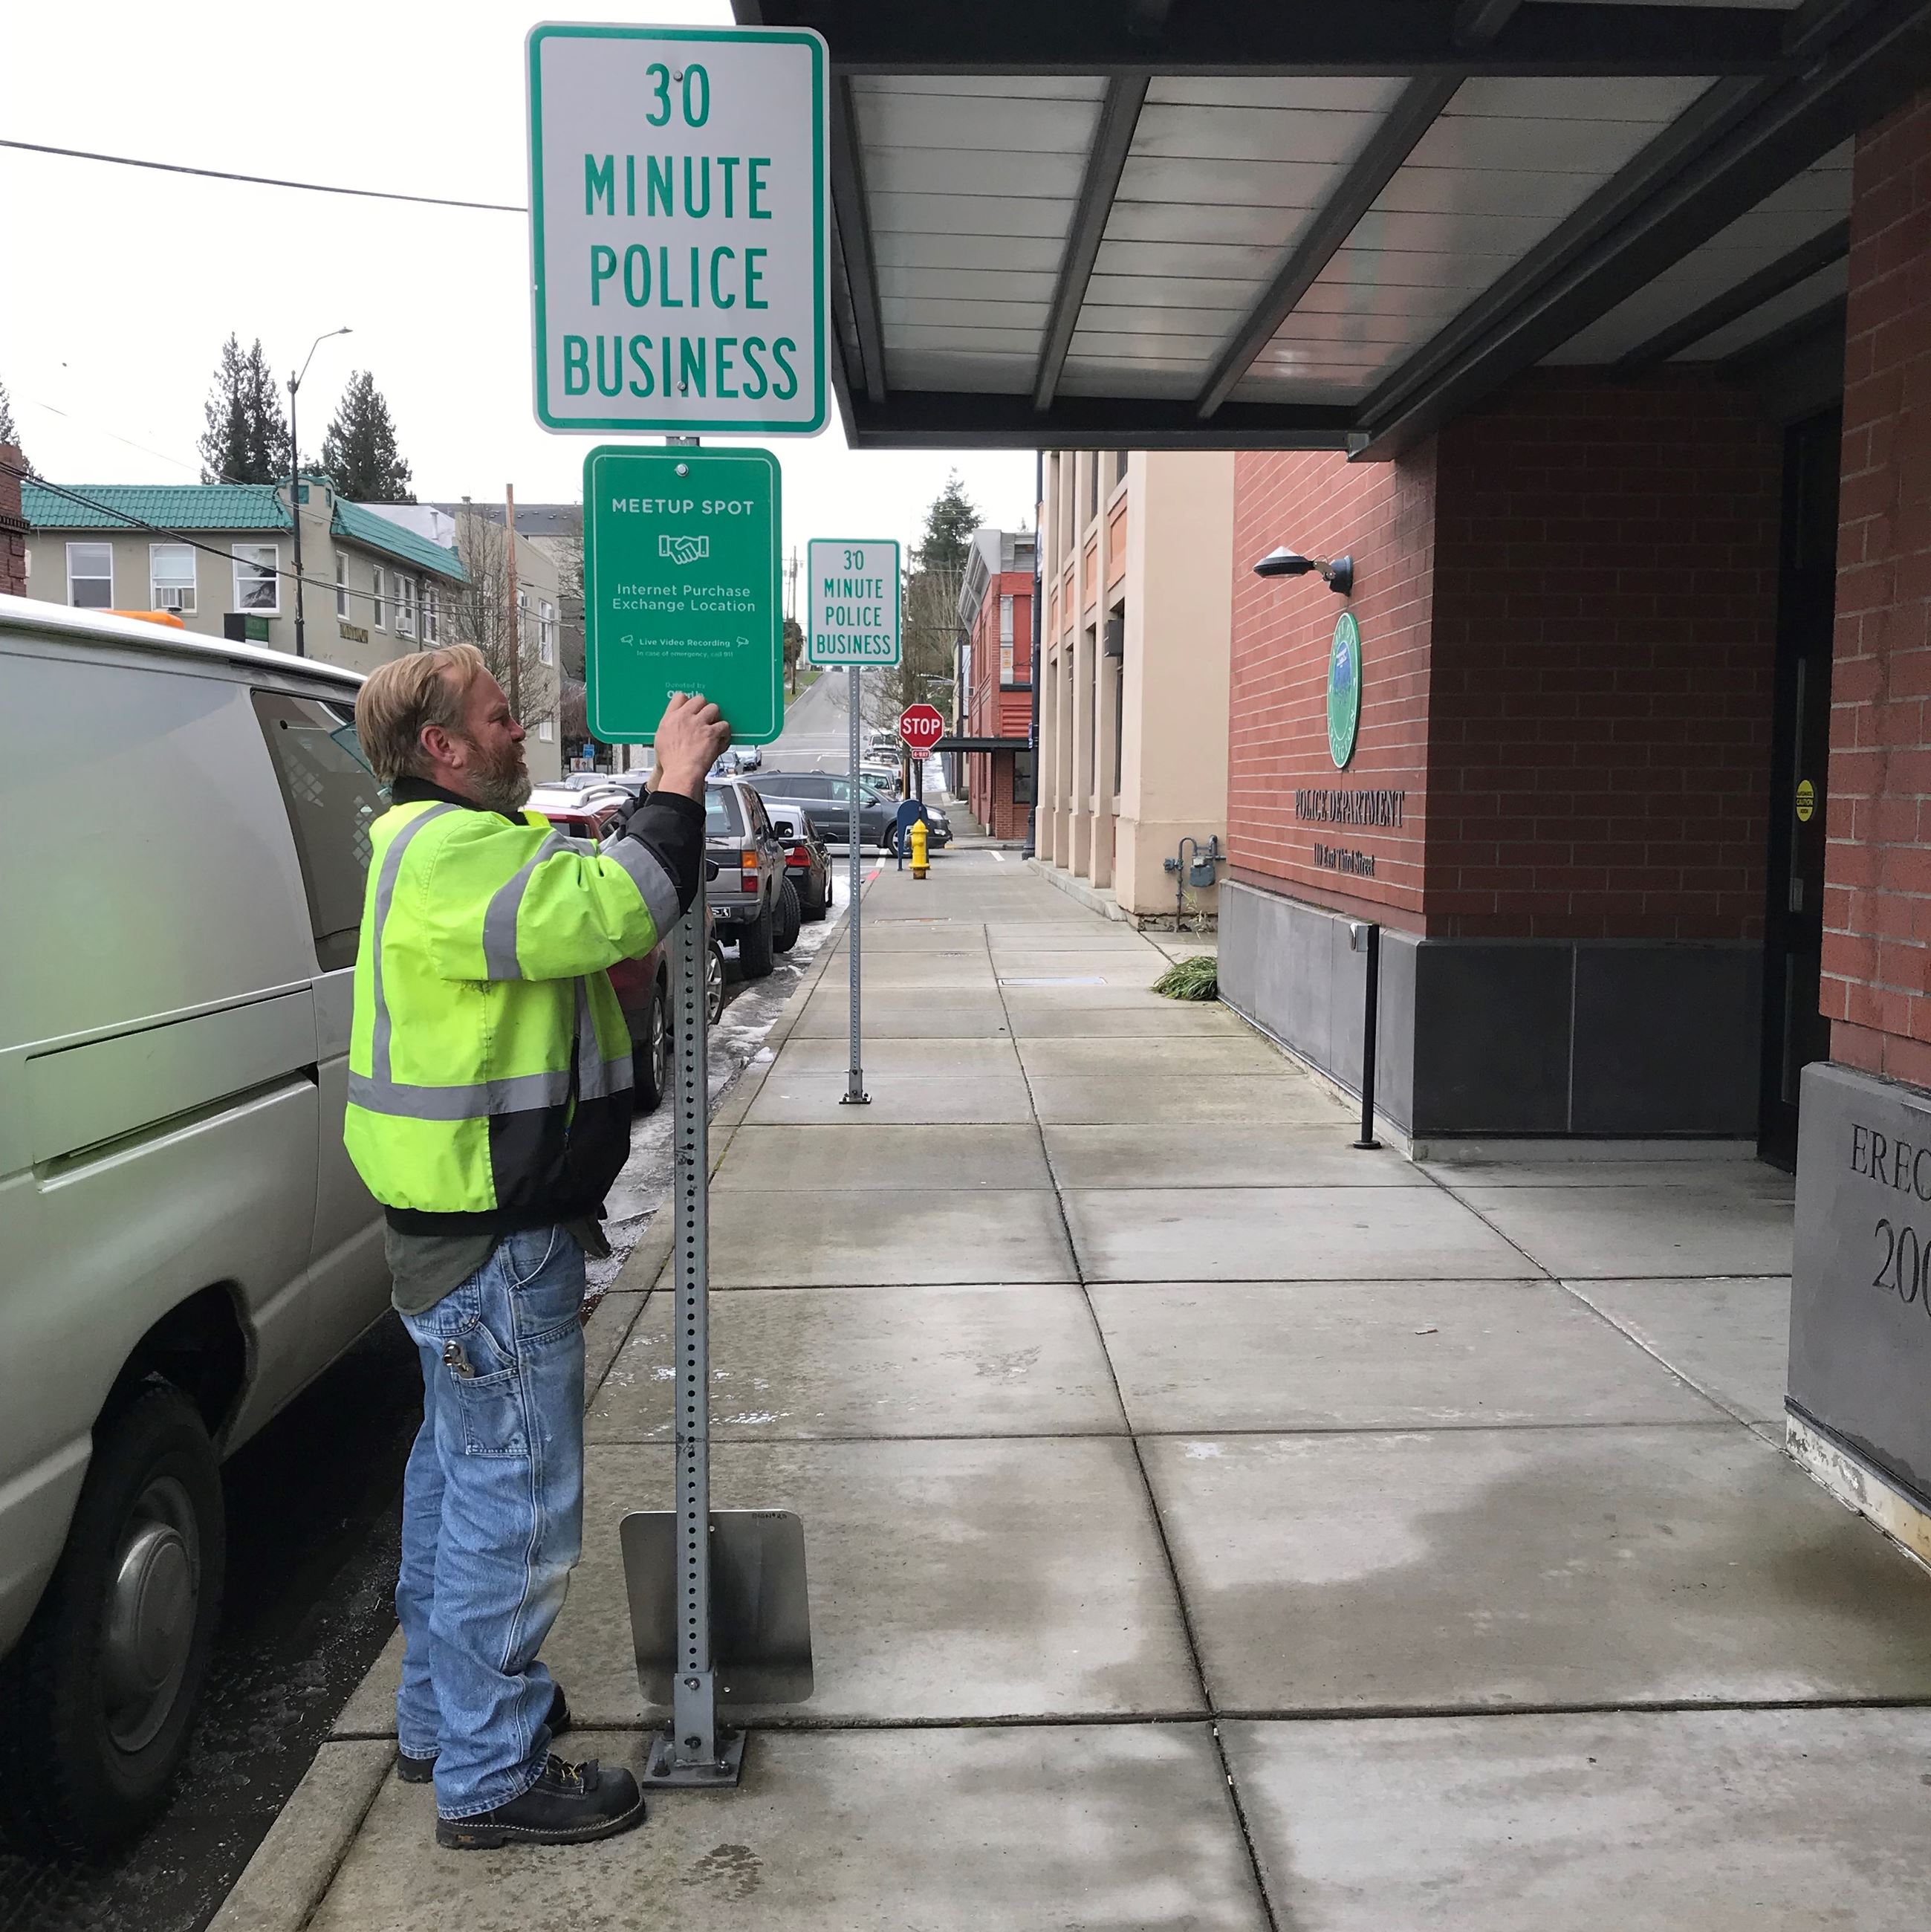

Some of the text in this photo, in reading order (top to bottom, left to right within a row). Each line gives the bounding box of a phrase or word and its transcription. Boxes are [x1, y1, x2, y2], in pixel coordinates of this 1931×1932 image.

[646, 62, 710, 128] 30
[585, 153, 773, 219] MINUTE
[591, 244, 769, 310] POLICE
[563, 334, 799, 400] BUSINESS
[611, 498, 755, 515] MEETUP SPOT
[843, 549, 865, 571] 30
[617, 583, 750, 597] Internet Purchase
[824, 578, 883, 599] MINUTE
[612, 598, 756, 612] Exchange Location
[825, 606, 882, 627] POLICE
[660, 638, 685, 646] Video
[687, 639, 731, 648] Recording
[817, 634, 891, 655] BUSINESS
[902, 718, 941, 736] STOP
[1295, 788, 1405, 828] POLICE DEPARTMENT
[1337, 848, 1354, 873] Third
[1354, 850, 1375, 877] Street
